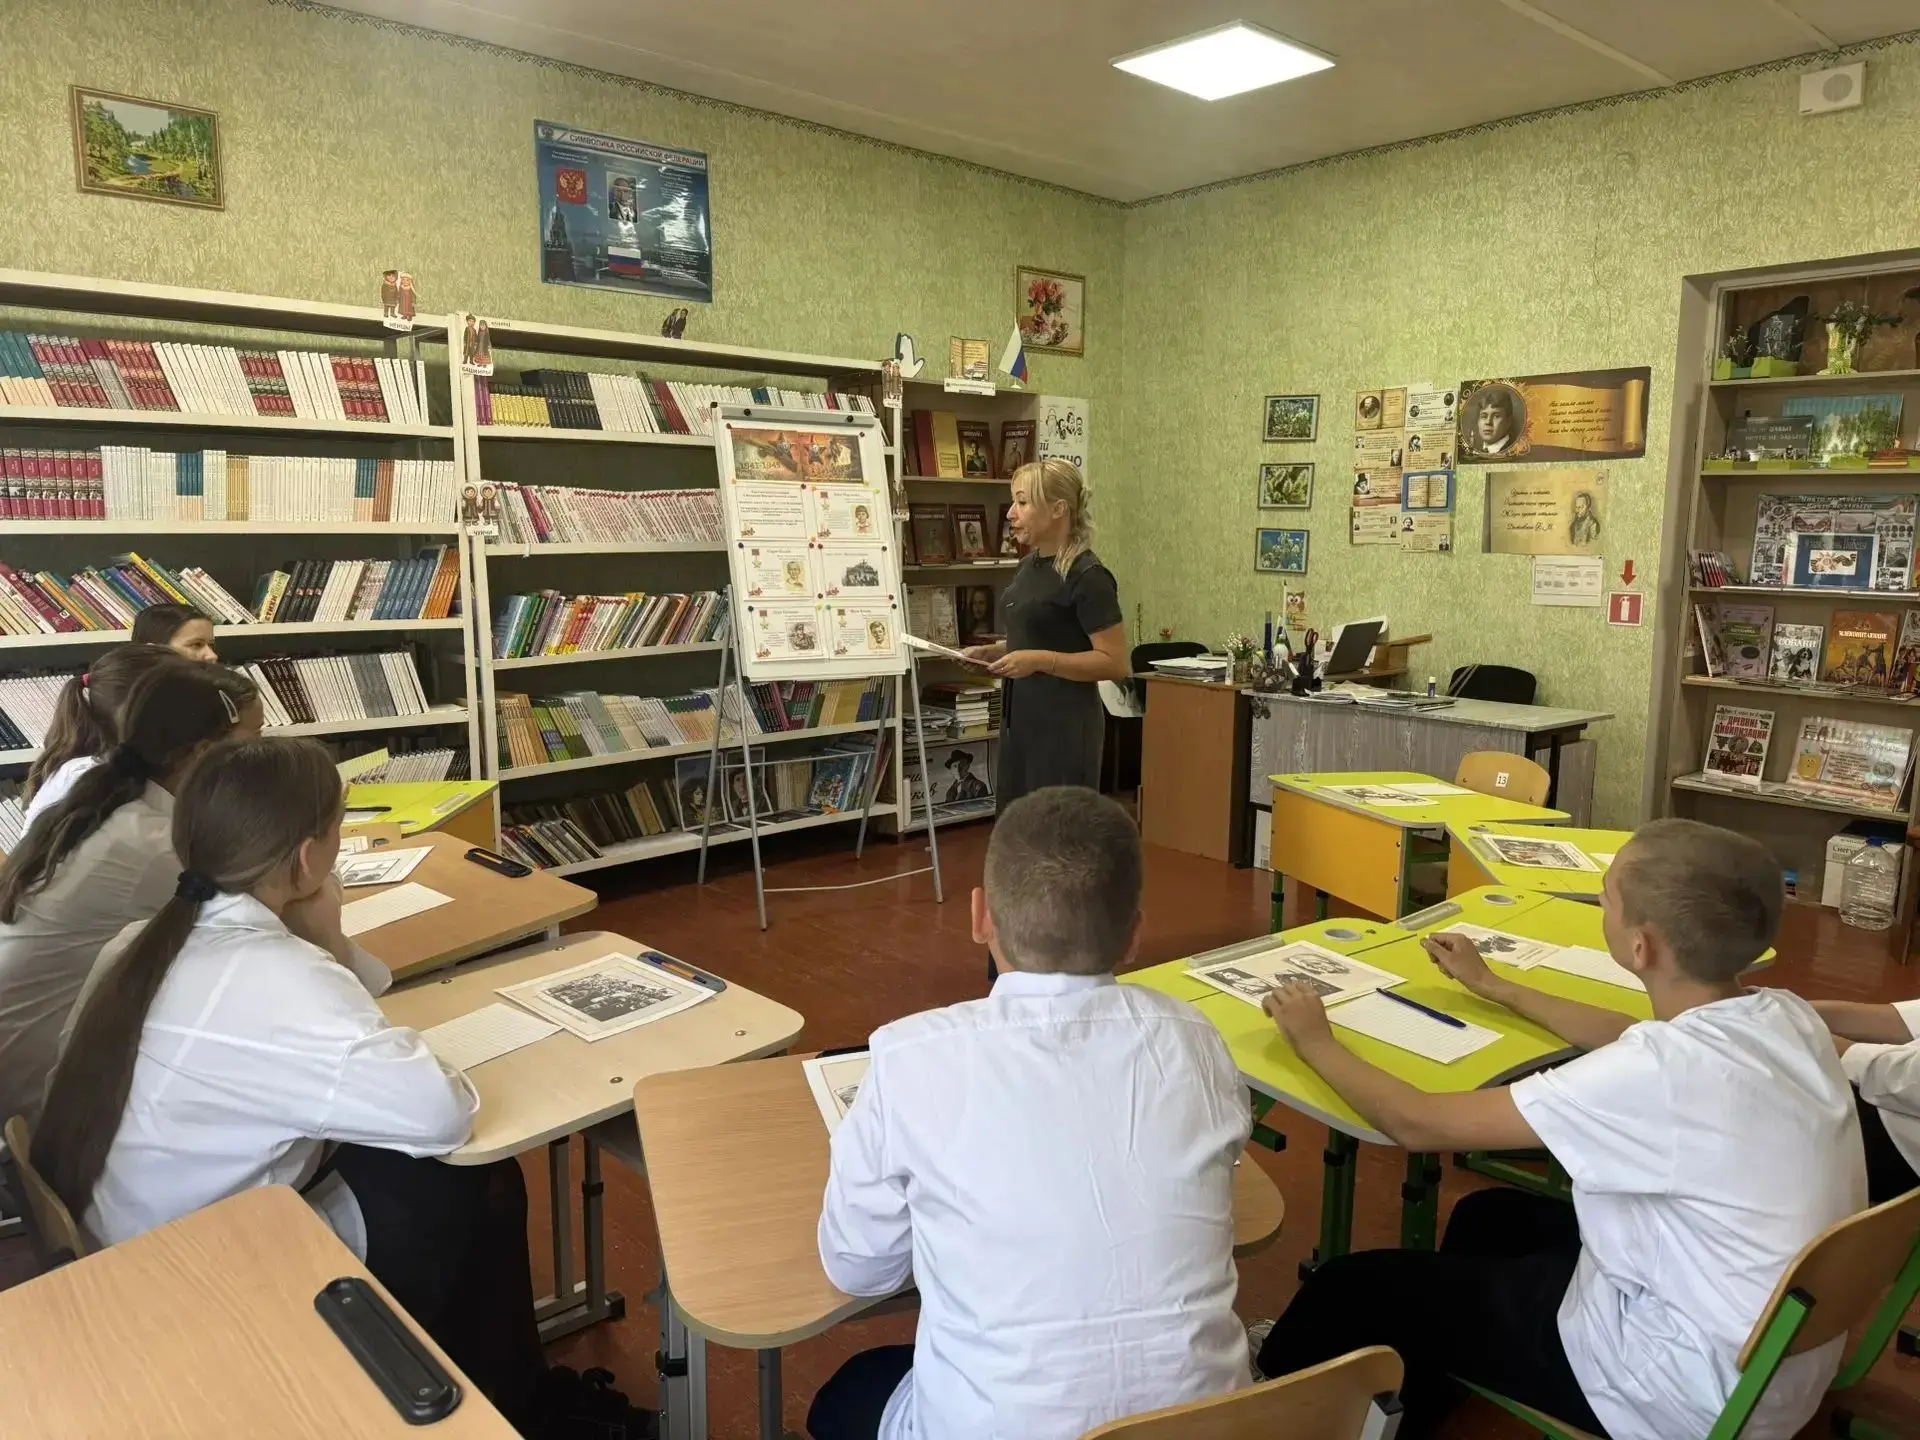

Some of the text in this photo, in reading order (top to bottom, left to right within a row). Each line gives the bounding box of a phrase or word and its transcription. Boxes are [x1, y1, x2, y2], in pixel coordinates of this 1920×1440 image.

[569, 134, 615, 150] СИМВОЛИКА
[1779, 638, 1817, 648] СОБАКИ
[1714, 724, 1768, 740] ЦИВИЛИЗАЦИИ
[1498, 776, 1507, 785] 13
